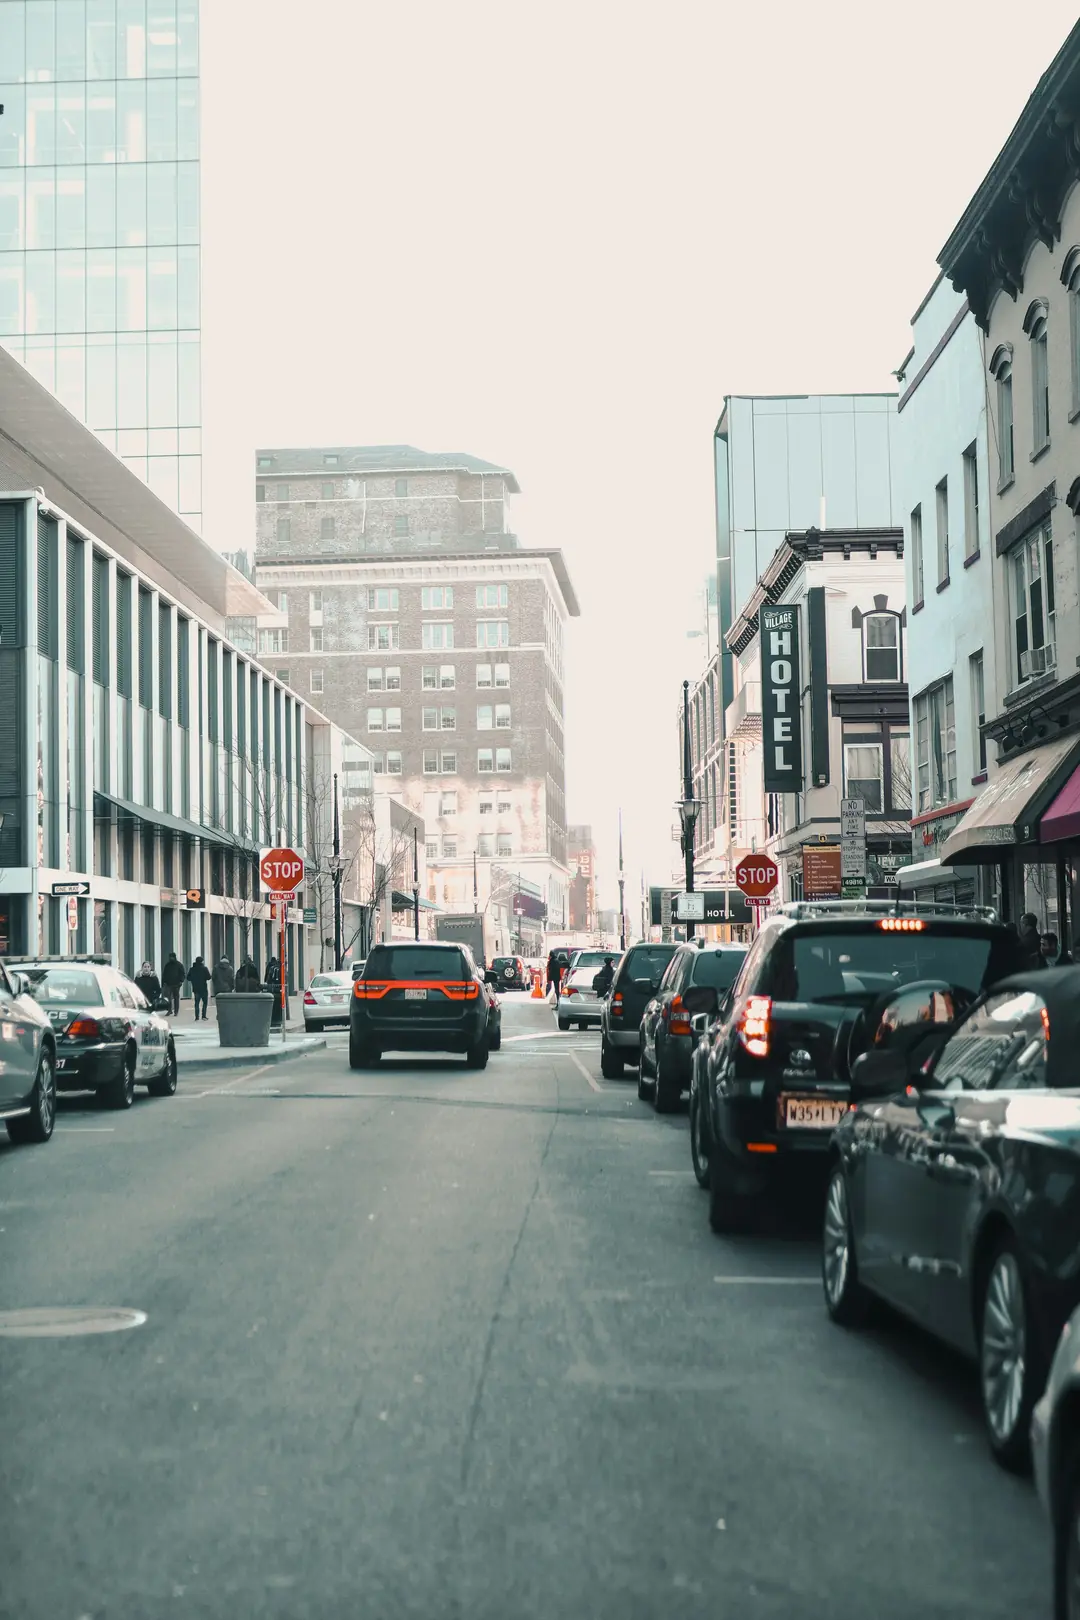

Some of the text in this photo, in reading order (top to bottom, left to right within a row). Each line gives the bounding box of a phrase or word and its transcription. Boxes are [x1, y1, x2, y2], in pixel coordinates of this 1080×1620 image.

[765, 612, 793, 628] VILLAGE
[770, 631, 793, 771] HOTEL
[848, 802, 858, 810] NO
[263, 862, 302, 878] STOP
[738, 868, 776, 884] STOP
